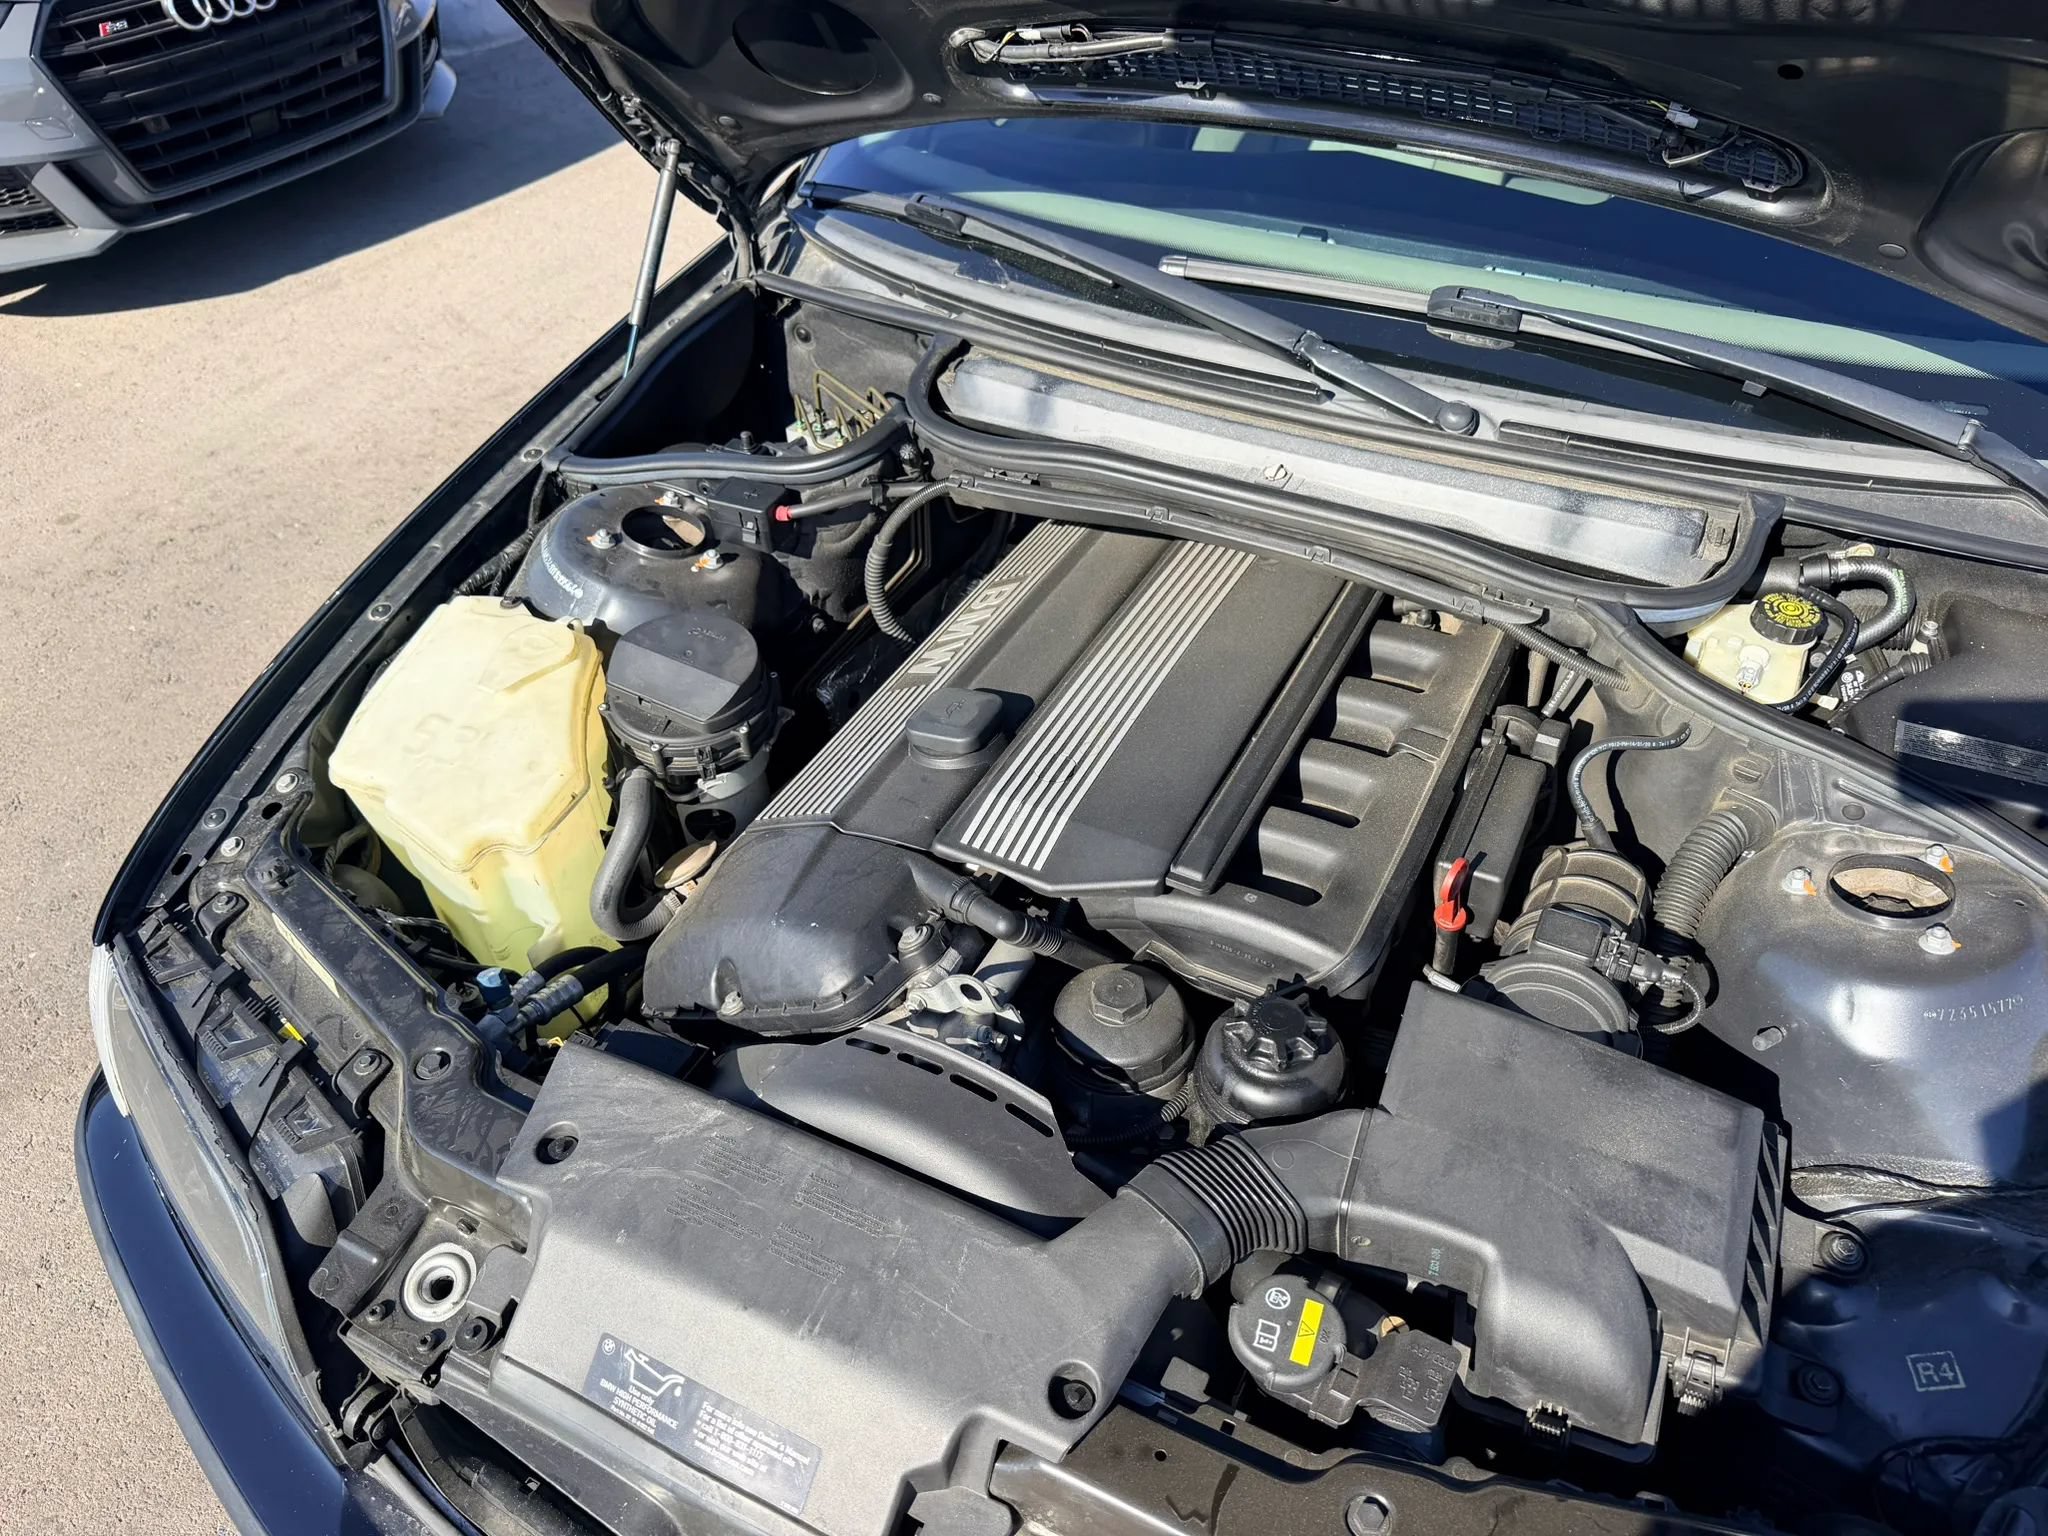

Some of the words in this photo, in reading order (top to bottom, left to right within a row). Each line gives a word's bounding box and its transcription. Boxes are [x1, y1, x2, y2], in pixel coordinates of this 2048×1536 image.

[906, 580, 1022, 674] BMW
[1916, 1362, 1955, 1384] R4
[600, 1378, 617, 1393] BMW
[616, 1387, 632, 1402] HIGH
[631, 1396, 679, 1430] PERFORMANCE
[628, 1385, 642, 1396] Use
[640, 1393, 655, 1406] only
[613, 1396, 647, 1421] SYNTHETIC
[699, 1410, 711, 1422] For
[702, 1401, 714, 1413] For
